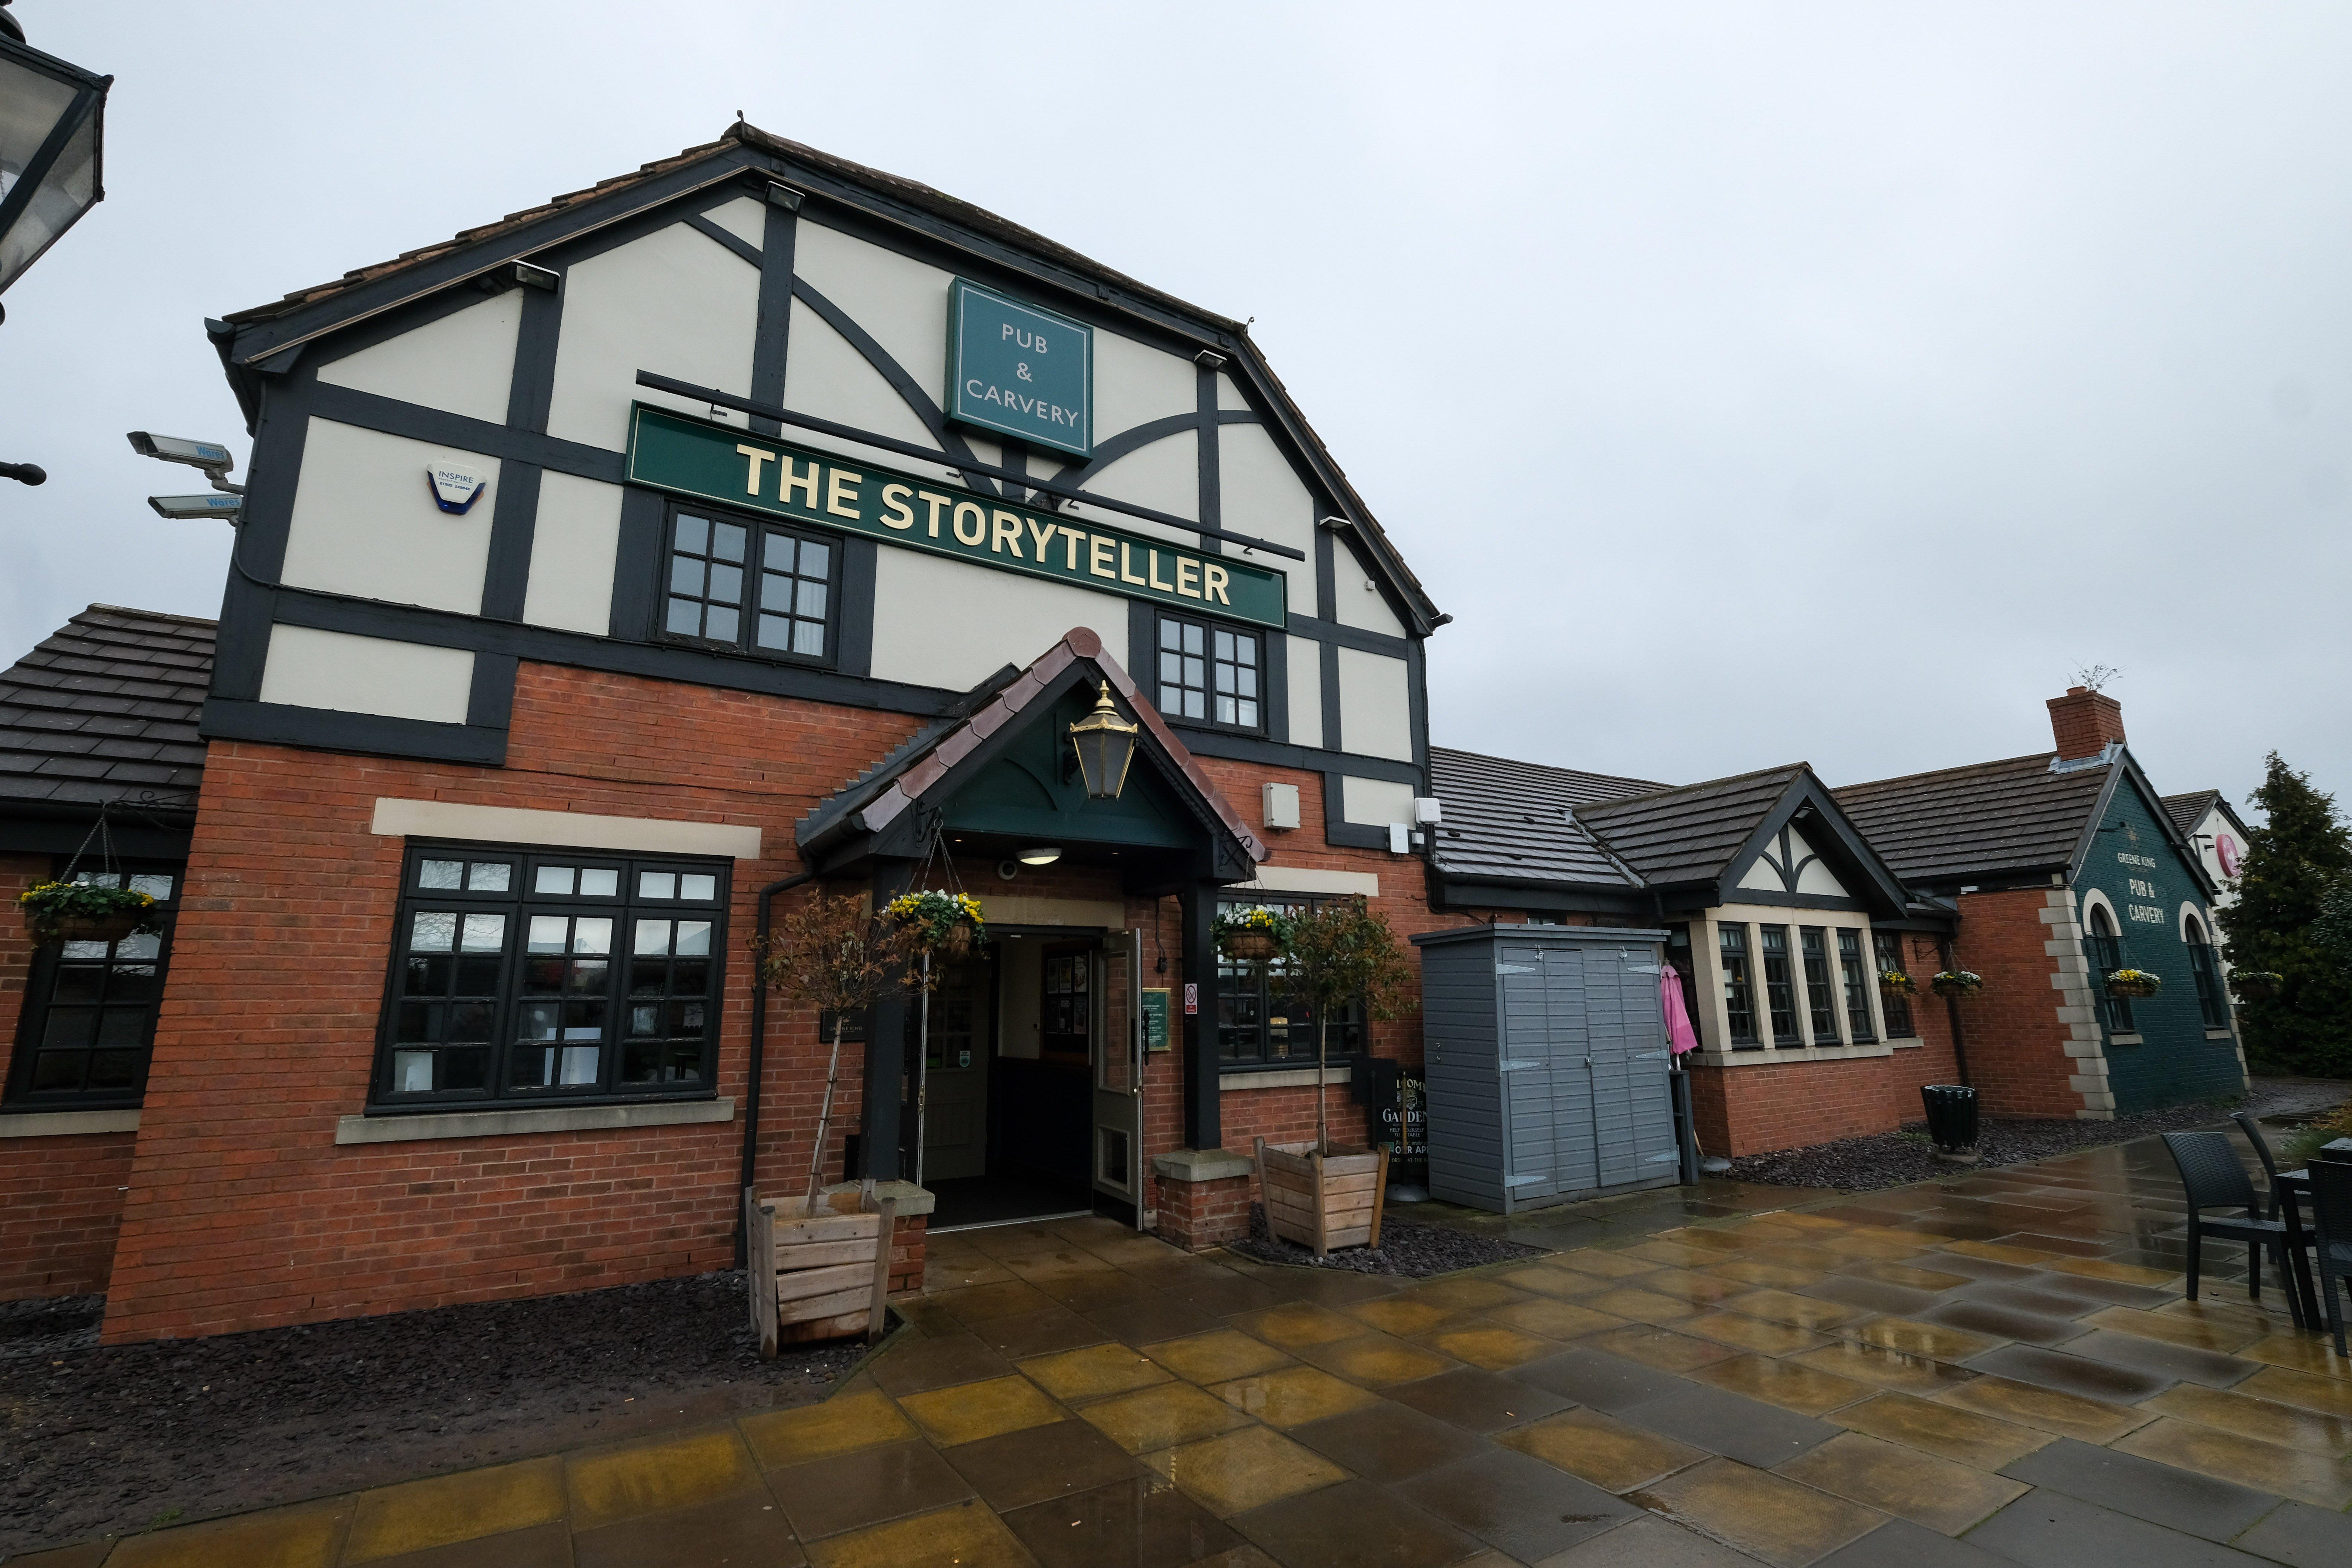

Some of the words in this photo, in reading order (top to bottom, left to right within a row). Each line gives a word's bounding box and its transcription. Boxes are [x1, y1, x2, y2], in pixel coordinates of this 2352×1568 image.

[1002, 323, 1047, 354] PUB
[1017, 362, 1032, 382] &
[966, 379, 1079, 427] CARVERY
[196, 446, 225, 459] Wares
[438, 470, 473, 484] INSPIRE
[207, 498, 240, 507] Wares
[737, 443, 863, 520] THE
[878, 483, 1230, 606] STORYTELLER
[2117, 852, 2141, 865] GREENE
[2141, 856, 2156, 868] KING
[2129, 878, 2147, 897] PUB
[2148, 882, 2156, 899] &
[2128, 904, 2164, 924] CARVERY
[1395, 1145, 1412, 1154] OR
